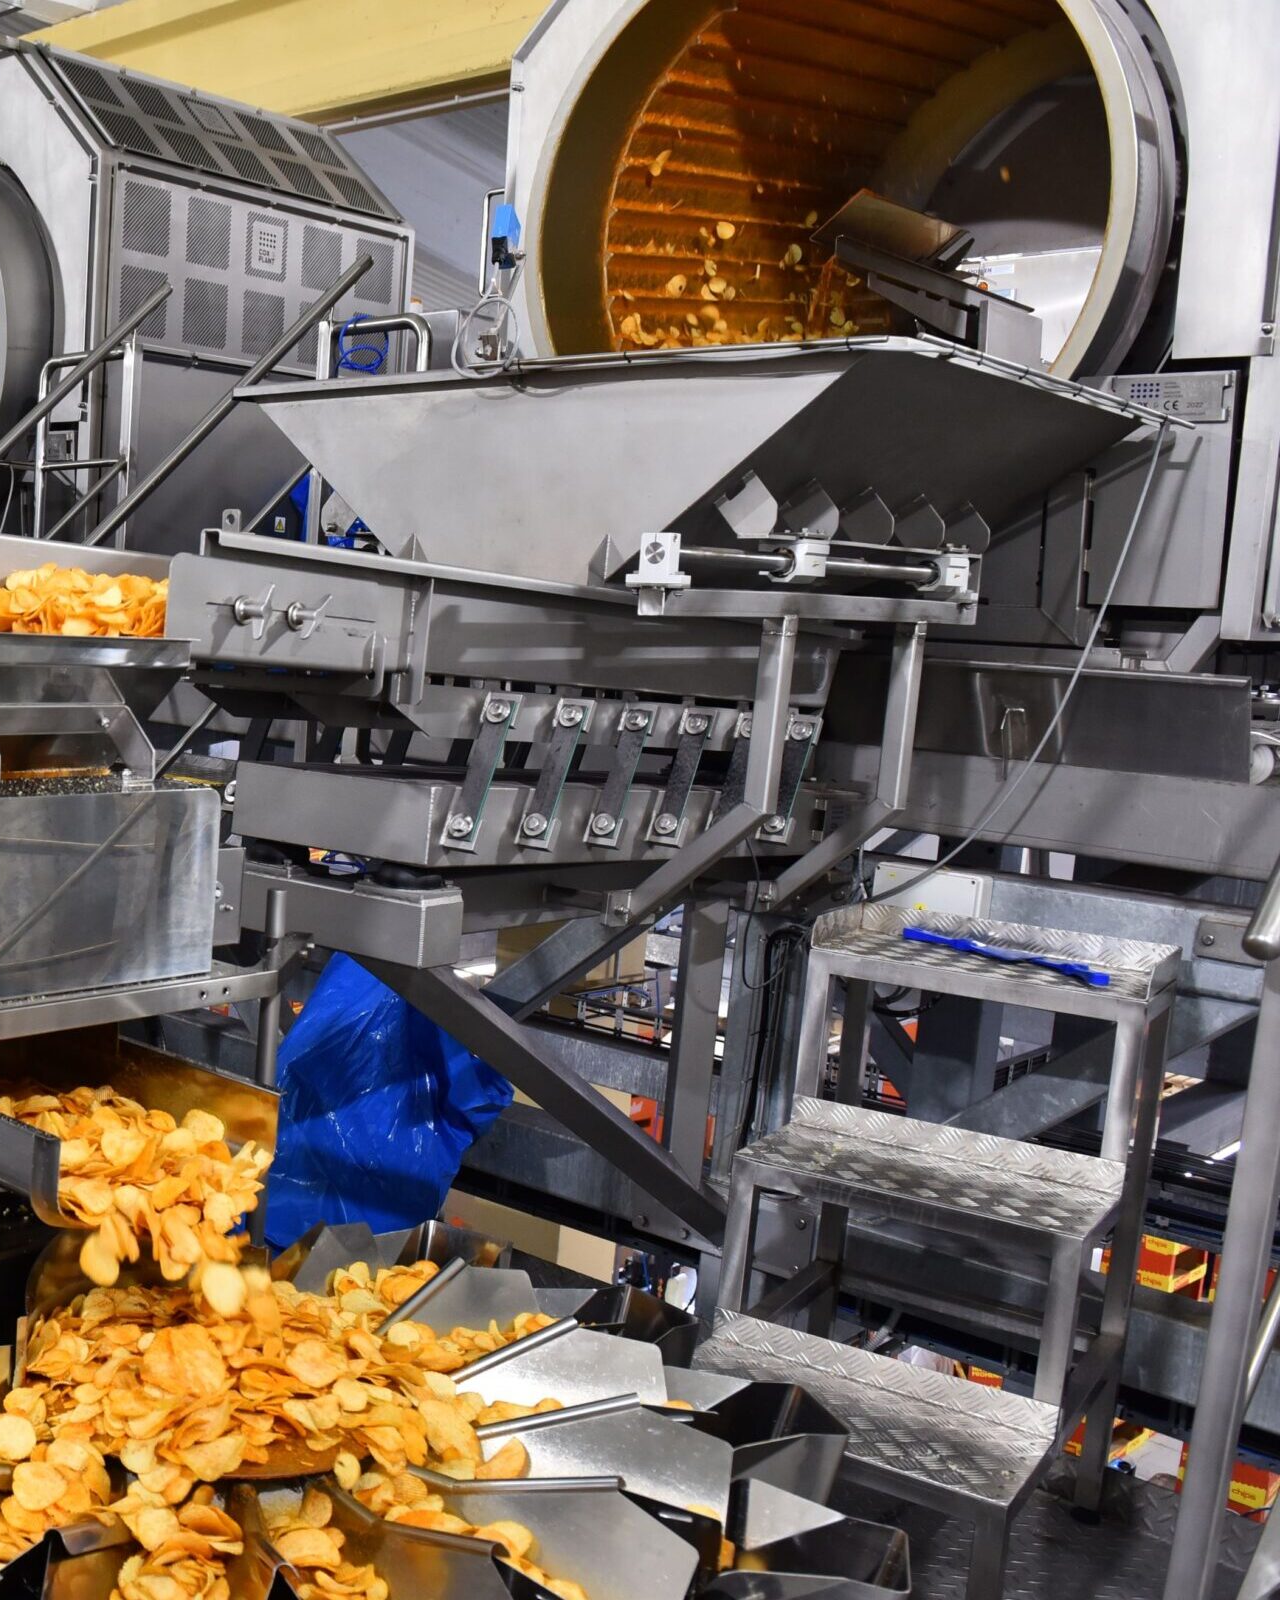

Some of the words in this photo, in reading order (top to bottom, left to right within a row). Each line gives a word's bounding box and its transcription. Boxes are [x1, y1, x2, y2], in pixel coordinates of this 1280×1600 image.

[1163, 400, 1179, 411] CE
[1142, 1275, 1162, 1286] chips
[1231, 1487, 1256, 1501] chips
